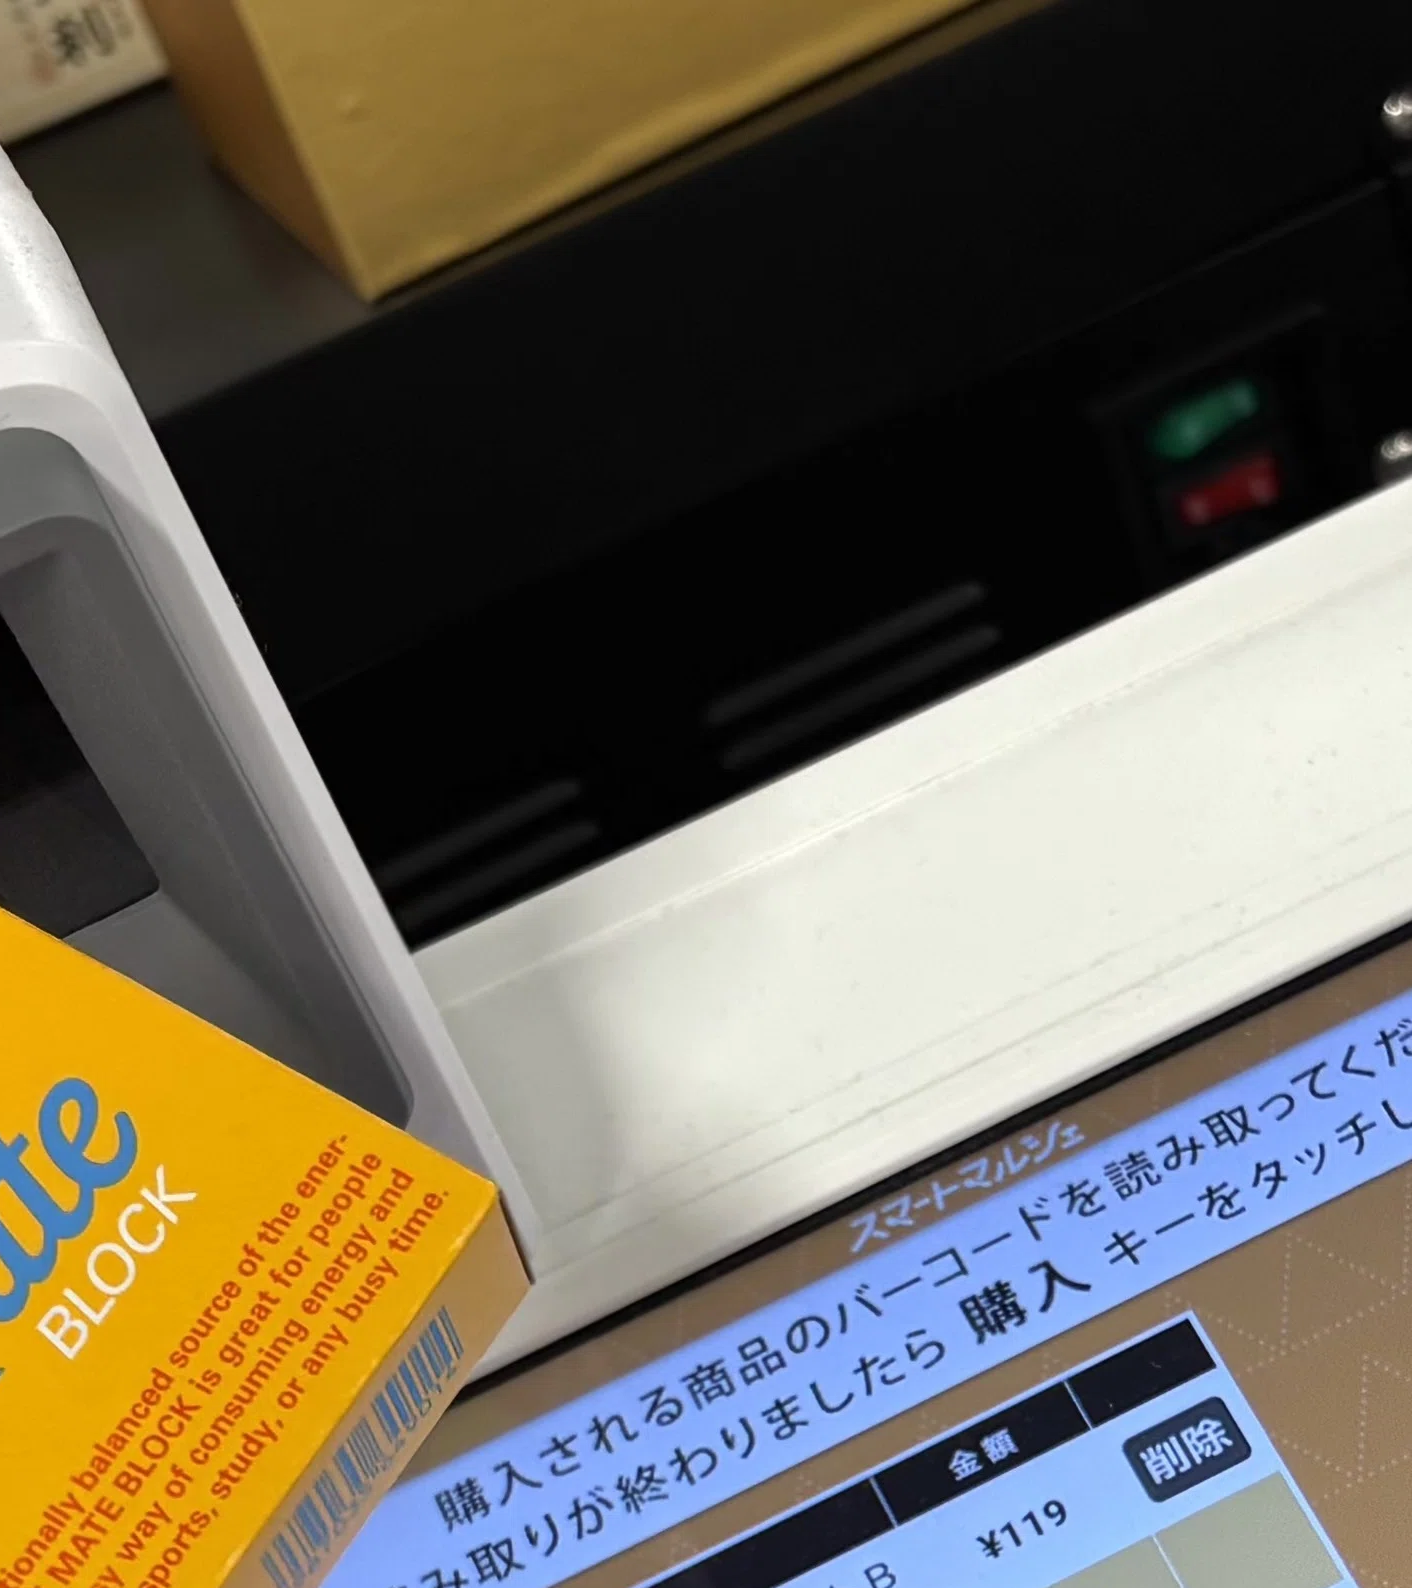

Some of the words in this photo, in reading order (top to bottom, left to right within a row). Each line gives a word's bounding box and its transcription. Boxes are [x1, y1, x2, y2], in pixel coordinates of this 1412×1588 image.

[35, 1163, 199, 1362] BLOCK
[848, 1121, 1085, 1254] スマートマルシェ
[45, 1494, 127, 1588] MATE
[112, 1394, 203, 1498] BLOCK
[187, 1366, 224, 1397] is
[218, 1288, 283, 1369] great
[268, 1244, 314, 1290] for
[306, 1151, 383, 1249] people
[70, 1366, 175, 1494] balanced
[169, 1279, 243, 1369] source
[237, 1242, 267, 1279] of
[256, 1201, 302, 1250] the
[295, 1134, 349, 1200] ener-
[115, 1500, 174, 1565] way
[164, 1463, 195, 1501] of
[189, 1316, 311, 1468] consuming
[300, 1221, 378, 1318] energy
[368, 1167, 416, 1224] and
[210, 1417, 285, 1501] study,
[276, 1376, 308, 1411] or
[300, 1324, 351, 1378] any
[334, 1254, 402, 1325] busy
[388, 1189, 451, 1254] time.
[959, 1259, 1092, 1345] 購入
[947, 1426, 1020, 1481] 金額
[976, 1499, 1067, 1559] ¥119
[1139, 1416, 1233, 1485] 削除
